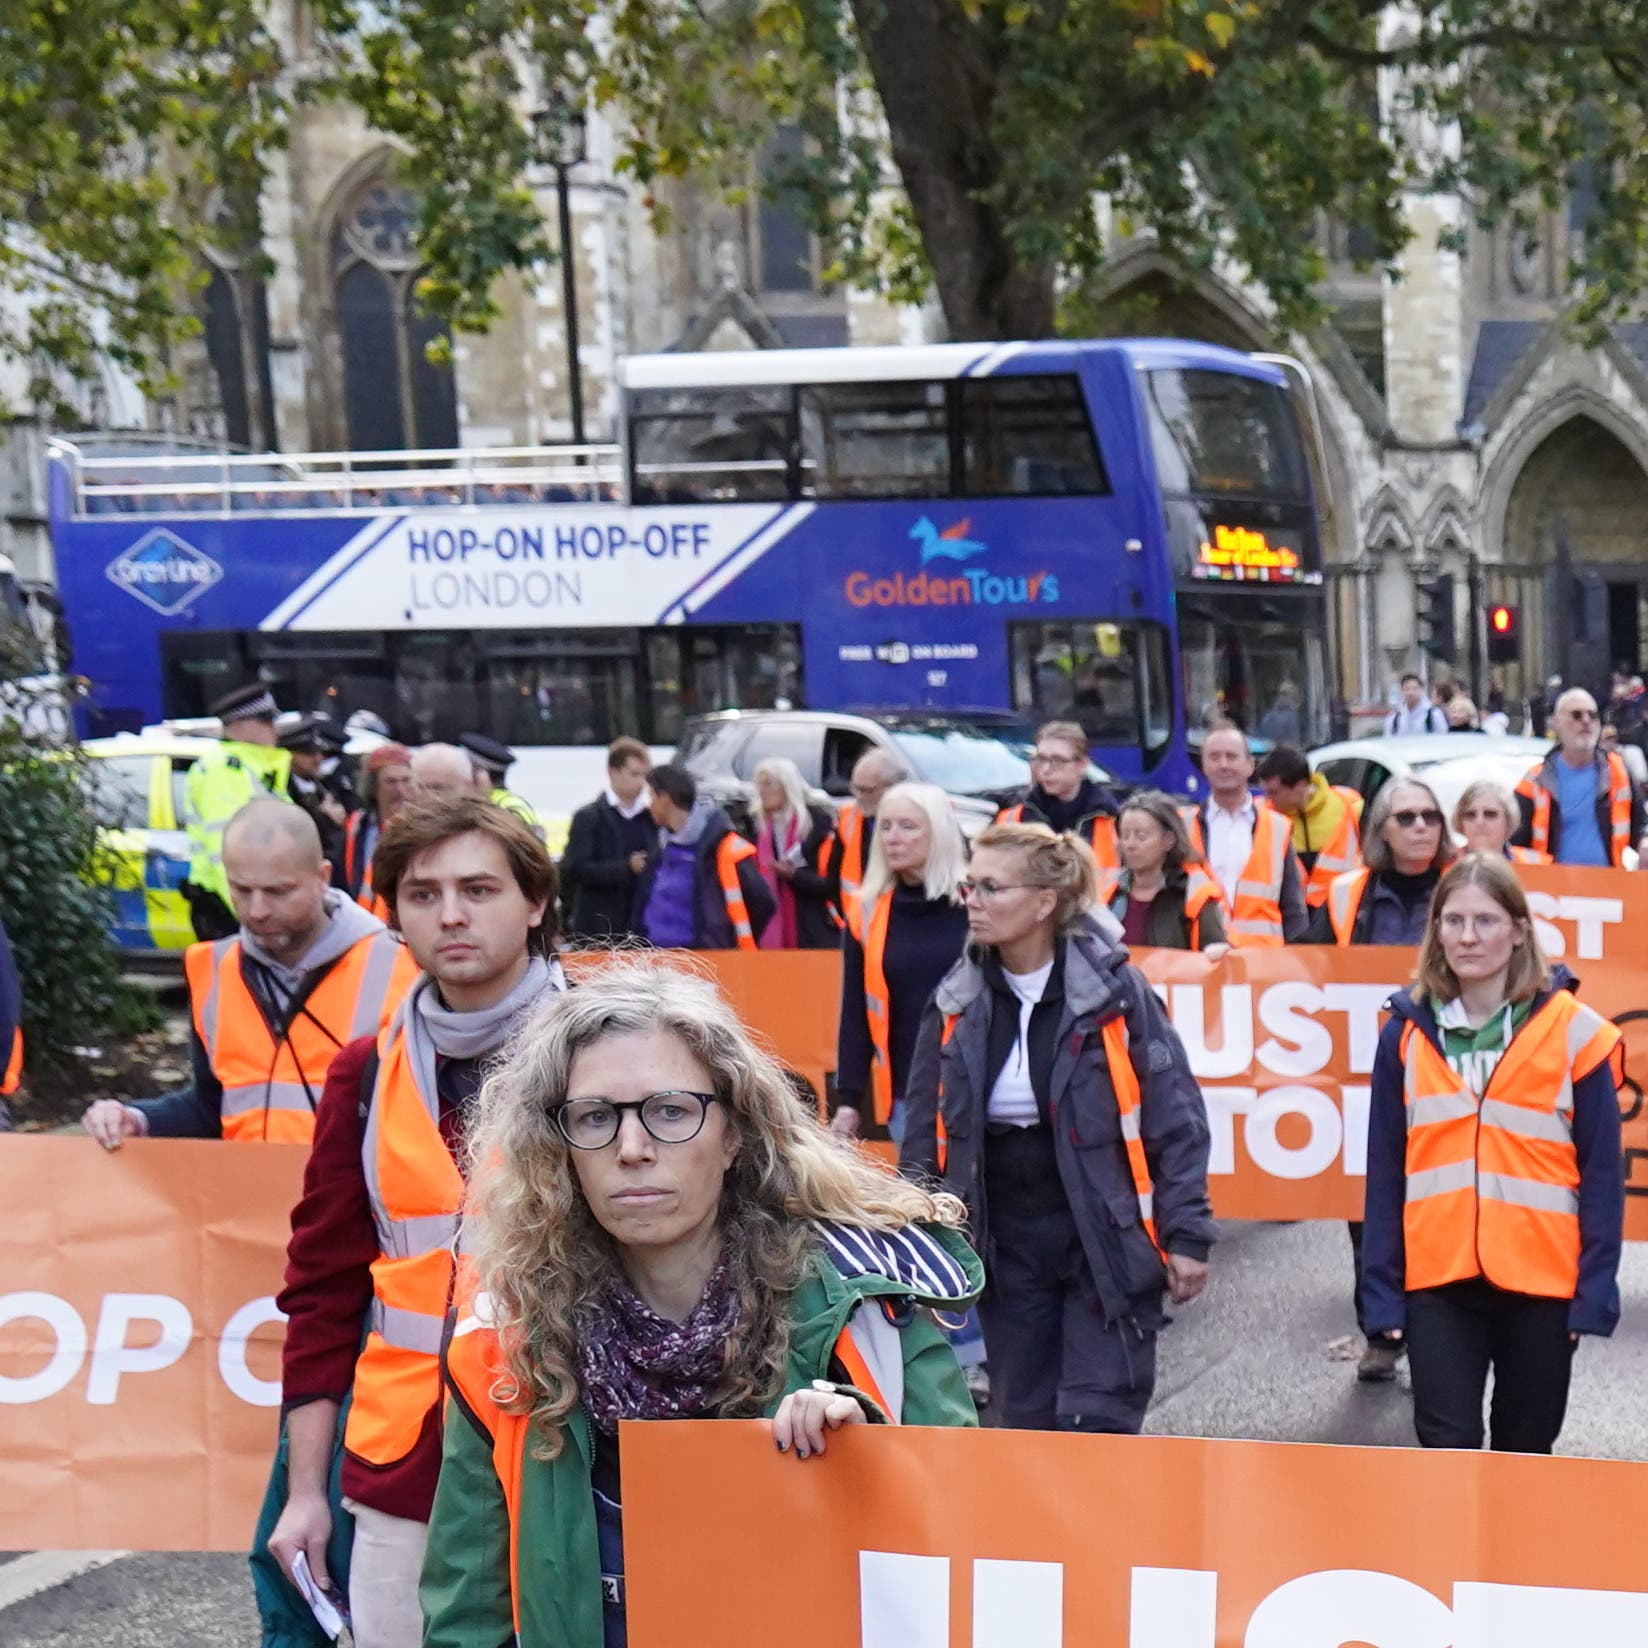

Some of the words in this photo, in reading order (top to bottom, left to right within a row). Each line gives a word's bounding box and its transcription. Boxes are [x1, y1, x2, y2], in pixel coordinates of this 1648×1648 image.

[408, 526, 544, 562] HOP-ON
[555, 523, 710, 559] HOP-OFF
[410, 569, 583, 609] LONDON
[1532, 892, 1624, 961] ST
[1155, 979, 1403, 1080] UST
[1200, 1083, 1372, 1181] TO
[0, 1287, 196, 1408] OP
